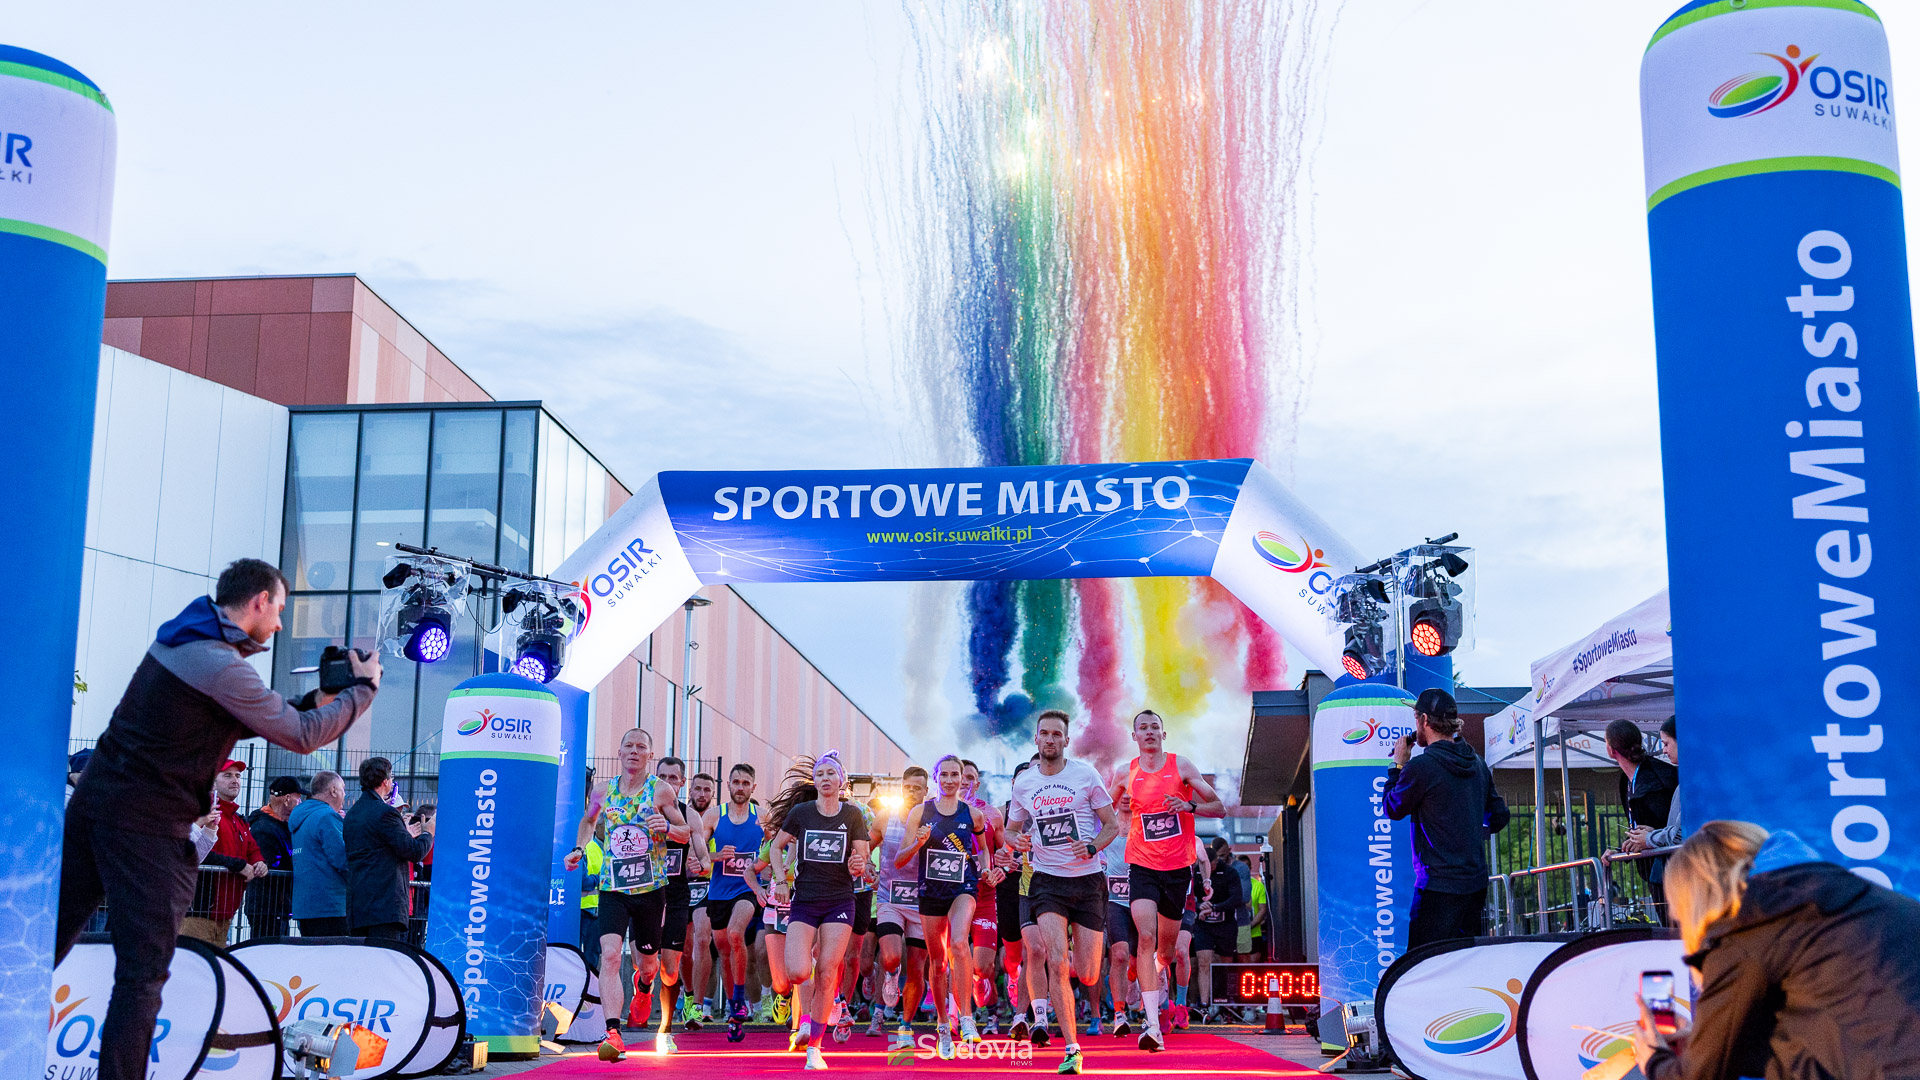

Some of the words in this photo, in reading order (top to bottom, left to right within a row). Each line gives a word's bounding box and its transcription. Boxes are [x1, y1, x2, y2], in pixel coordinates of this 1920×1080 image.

[1810, 66, 1890, 115] OSIR
[712, 482, 984, 521] SPORTOWE
[997, 475, 1191, 515] MIASTO
[591, 538, 654, 597] OSIR
[1785, 229, 1894, 890] ortoweMiasto
[1572, 627, 1637, 675] #SportoweMiasto
[491, 717, 532, 734] OSIR
[1031, 787, 1044, 800] BANK
[1053, 784, 1076, 796] AMERICA
[1033, 796, 1074, 810] Chicago
[1042, 821, 1073, 838] 474
[1146, 816, 1175, 832] 456
[808, 838, 841, 853] 454
[618, 861, 646, 878] 415
[930, 858, 961, 873] 426
[463, 768, 498, 1021] #SportoweMiasto
